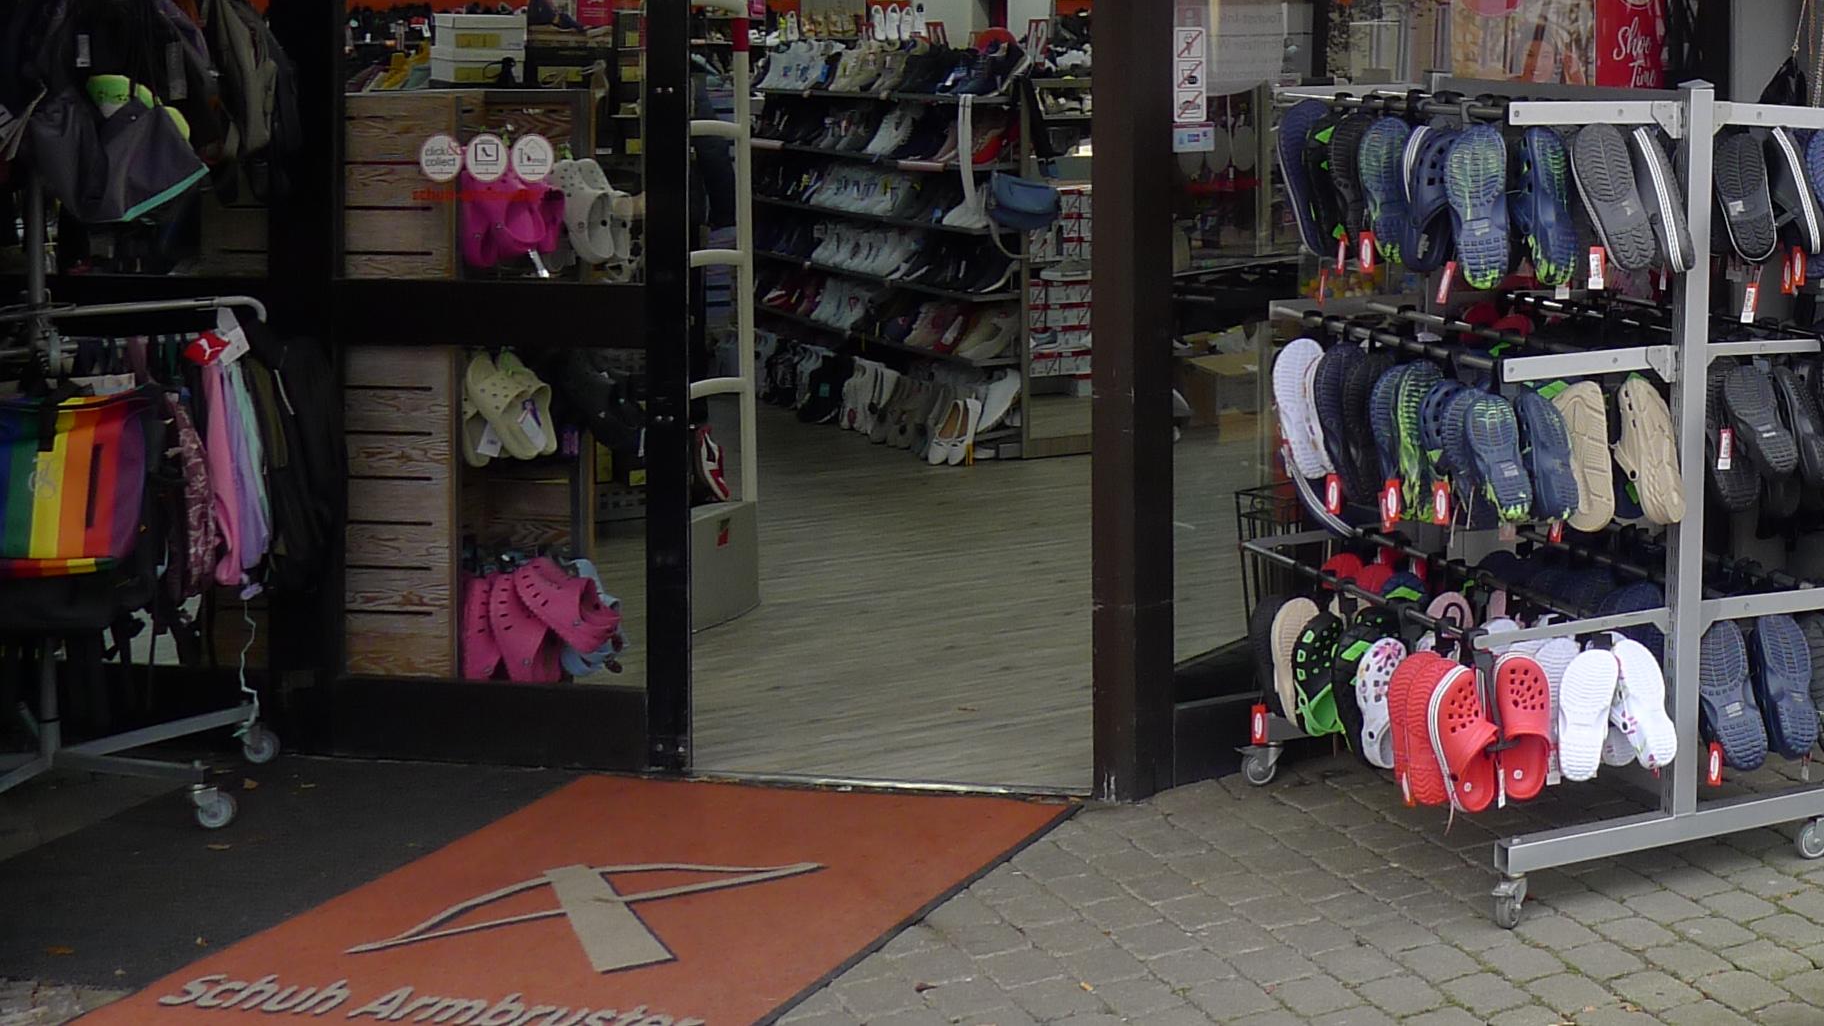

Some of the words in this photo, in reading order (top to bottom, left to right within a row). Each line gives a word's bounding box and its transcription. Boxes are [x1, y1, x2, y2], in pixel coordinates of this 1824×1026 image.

[1612, 17, 1651, 61] Shoe
[425, 146, 448, 157] click
[425, 157, 456, 168] collect
[158, 974, 353, 1015] Schuh
